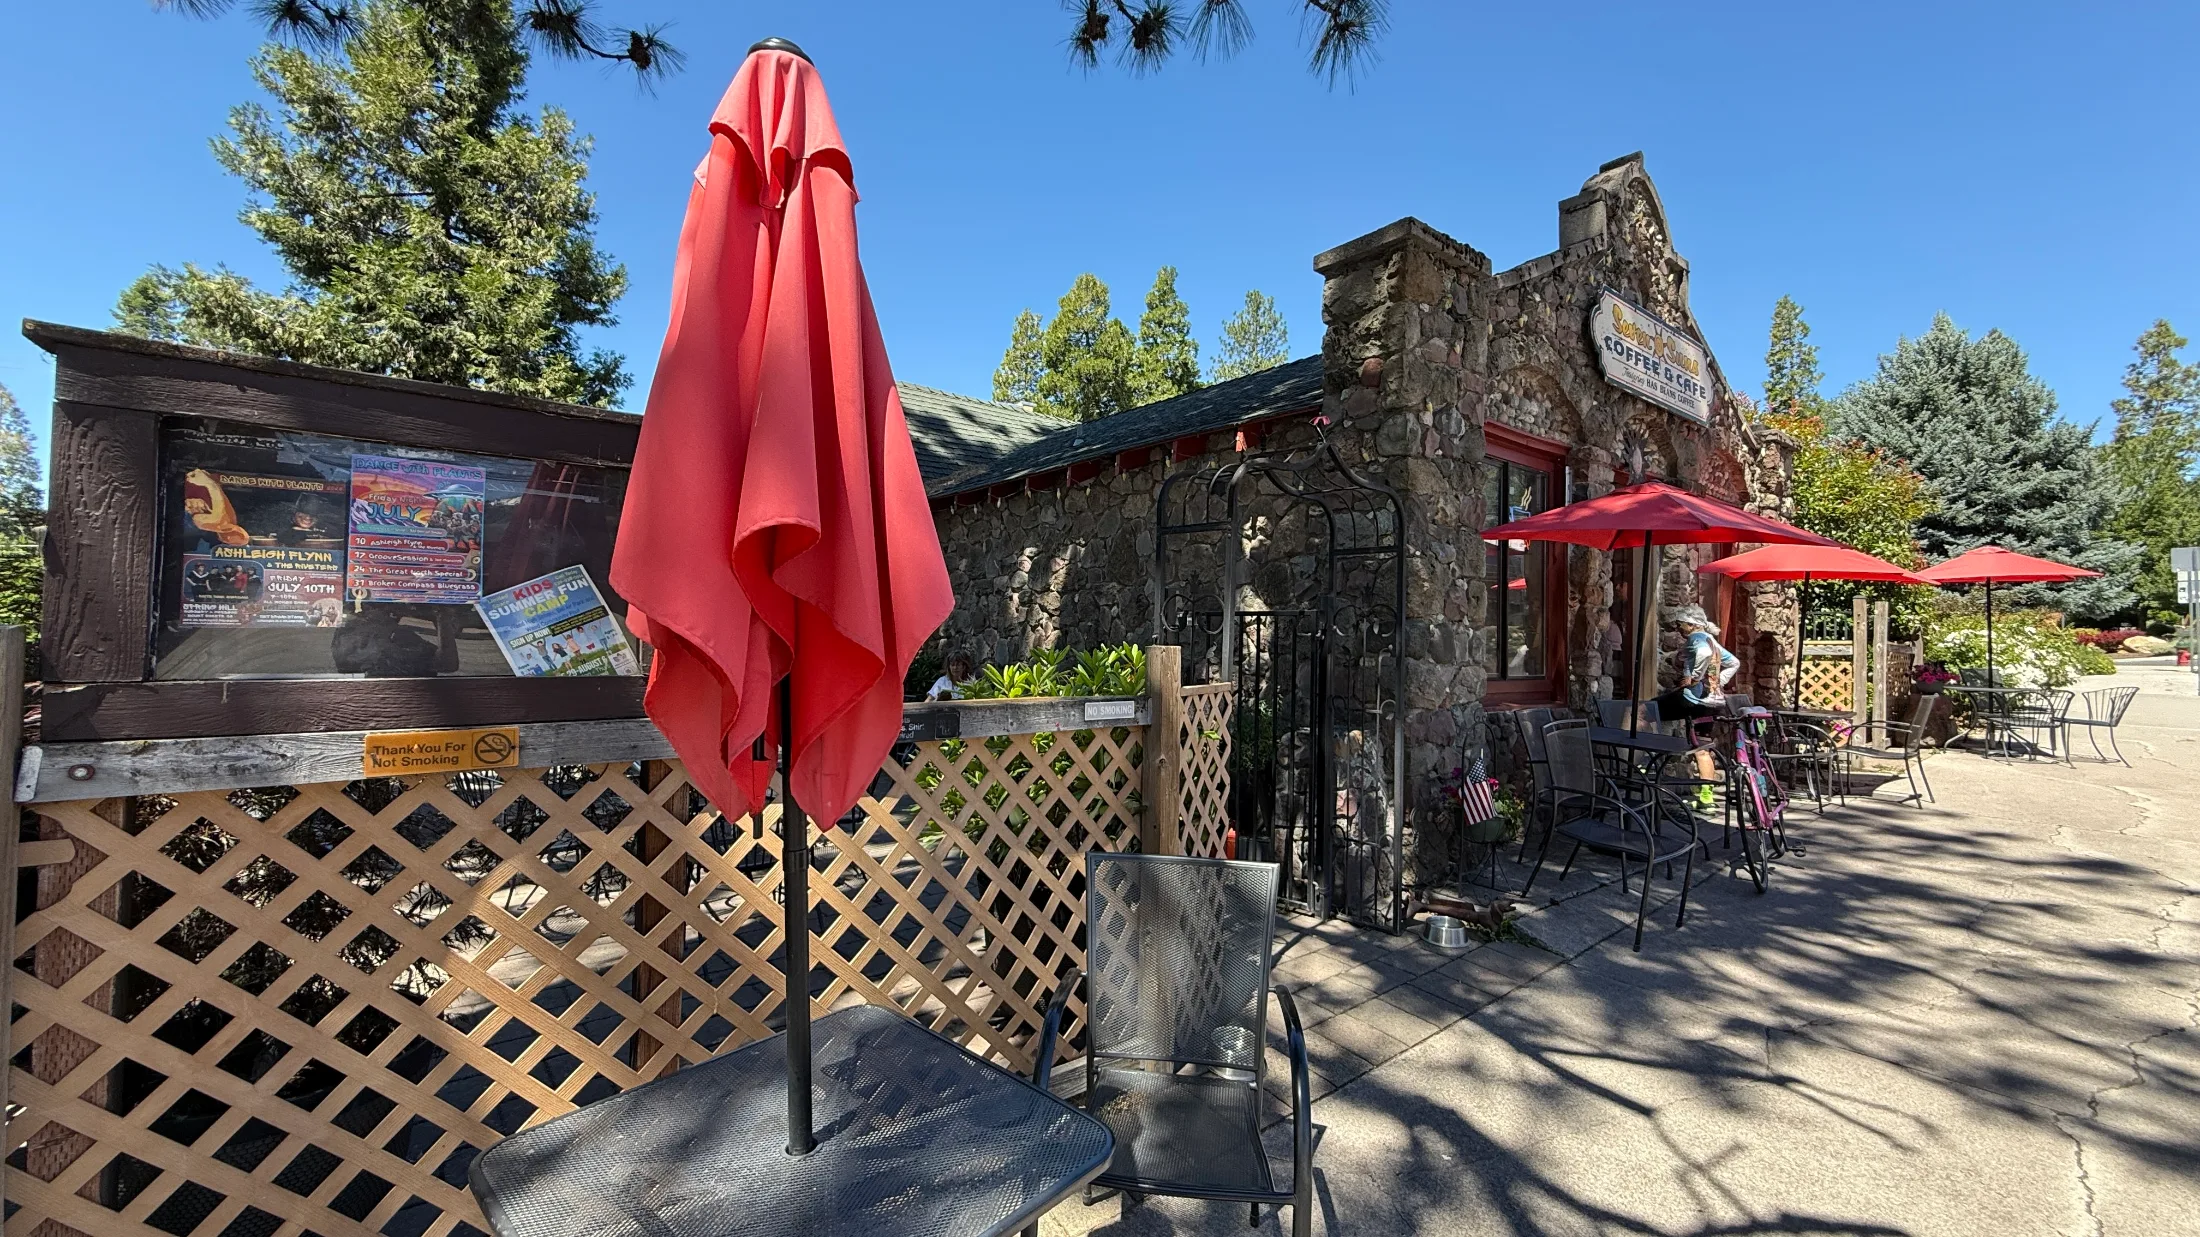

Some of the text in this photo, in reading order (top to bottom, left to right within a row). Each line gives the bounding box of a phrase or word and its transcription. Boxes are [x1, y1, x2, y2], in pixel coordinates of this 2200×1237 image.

[1612, 304, 1699, 376] Seven Suns
[1604, 335, 1706, 399] COFFEE & CAFE
[1646, 379, 1658, 391] HAS
[1660, 384, 1676, 401] BEANS
[1677, 395, 1695, 409] COFFEE
[355, 458, 482, 479] DANCE with PLANTS
[258, 479, 284, 487] WITH
[368, 493, 397, 503] Friday
[367, 502, 421, 521] JULY
[355, 537, 366, 545] 10
[215, 547, 332, 562] ASHLEIGH FLYNN
[354, 551, 366, 559] 17
[368, 553, 429, 562] GrooveSession
[275, 562, 293, 570] THE
[269, 575, 305, 583] FRIDAY
[434, 570, 463, 578] Special
[268, 583, 336, 594] JULY 10TH
[353, 579, 365, 587] 31
[398, 580, 435, 589] Compass
[437, 582, 476, 590] Bluegrass
[513, 579, 554, 601] KIDS
[488, 589, 557, 620] SUMMER
[558, 579, 589, 595] FUN
[524, 594, 569, 618] CAMP
[510, 627, 551, 648] SIGN UP NOW!
[1087, 704, 1133, 716] NO SMOKING
[373, 742, 466, 755] Thank You For
[373, 755, 460, 768] Not Smoking
